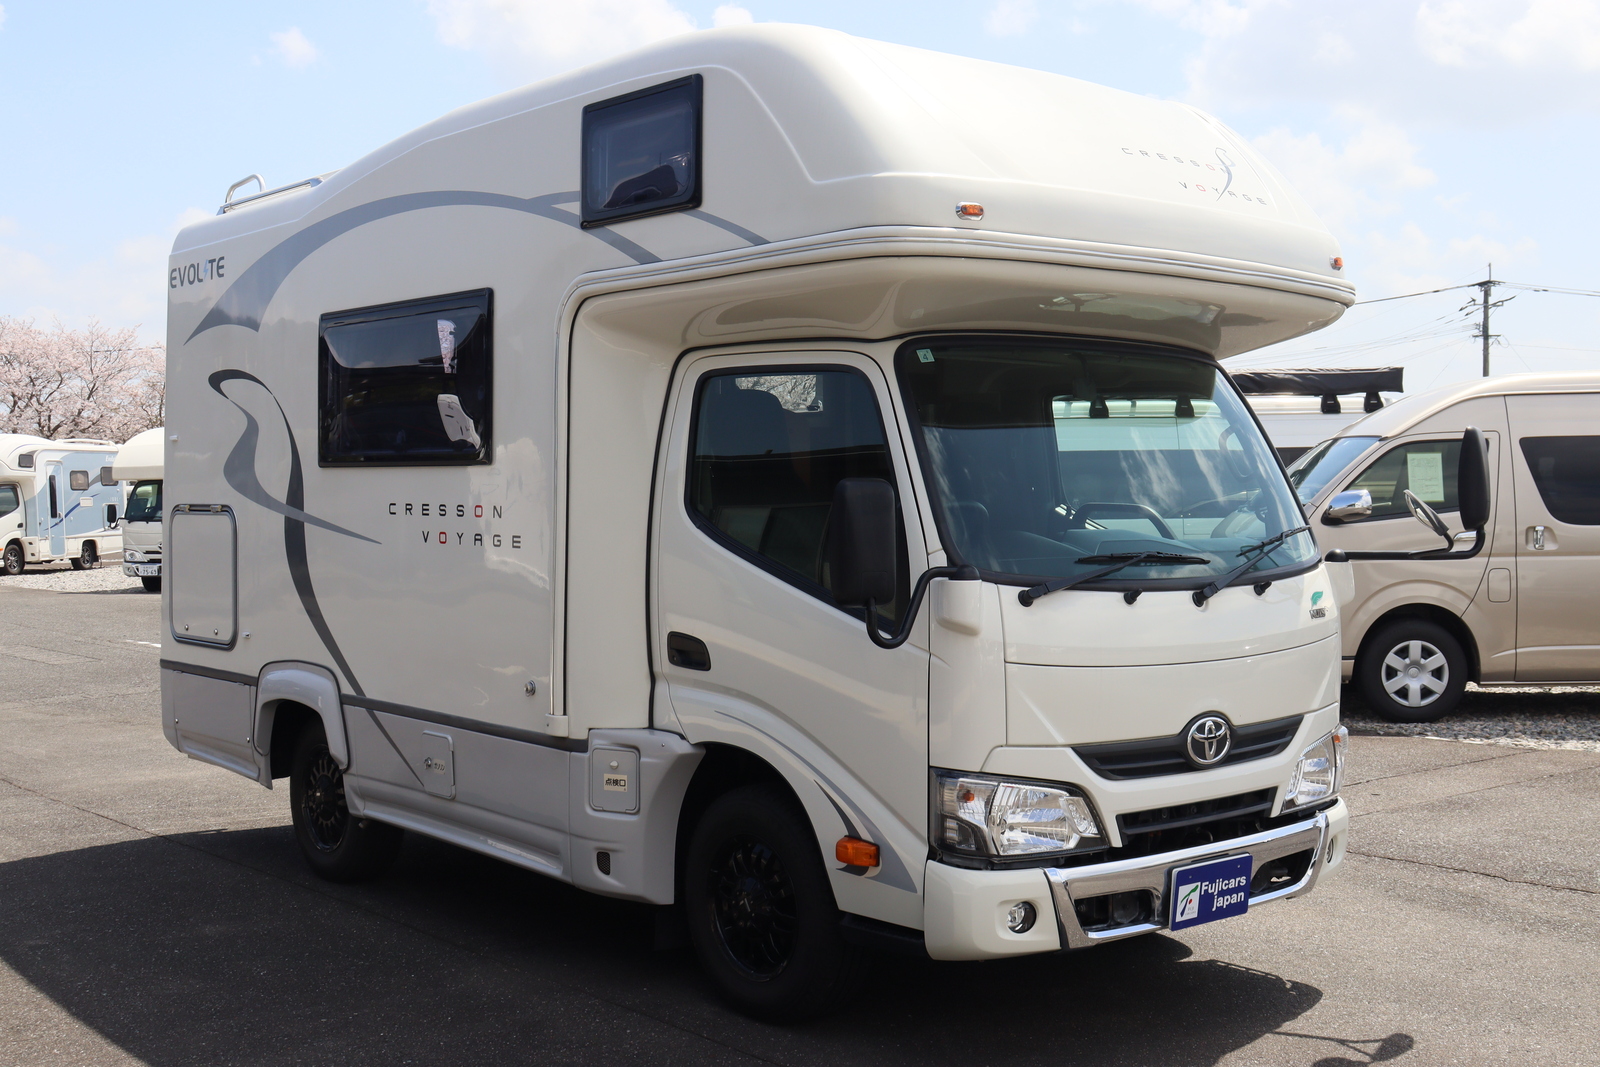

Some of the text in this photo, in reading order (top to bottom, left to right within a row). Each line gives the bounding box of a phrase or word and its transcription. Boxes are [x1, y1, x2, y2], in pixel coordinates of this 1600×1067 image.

[1178, 181, 1267, 205] VOYAGE
[388, 502, 502, 519] CRESSON
[422, 530, 522, 549] VOYAGE
[605, 778, 626, 787] 点検口
[1201, 876, 1247, 896] Fujicars
[1212, 891, 1245, 912] japan
